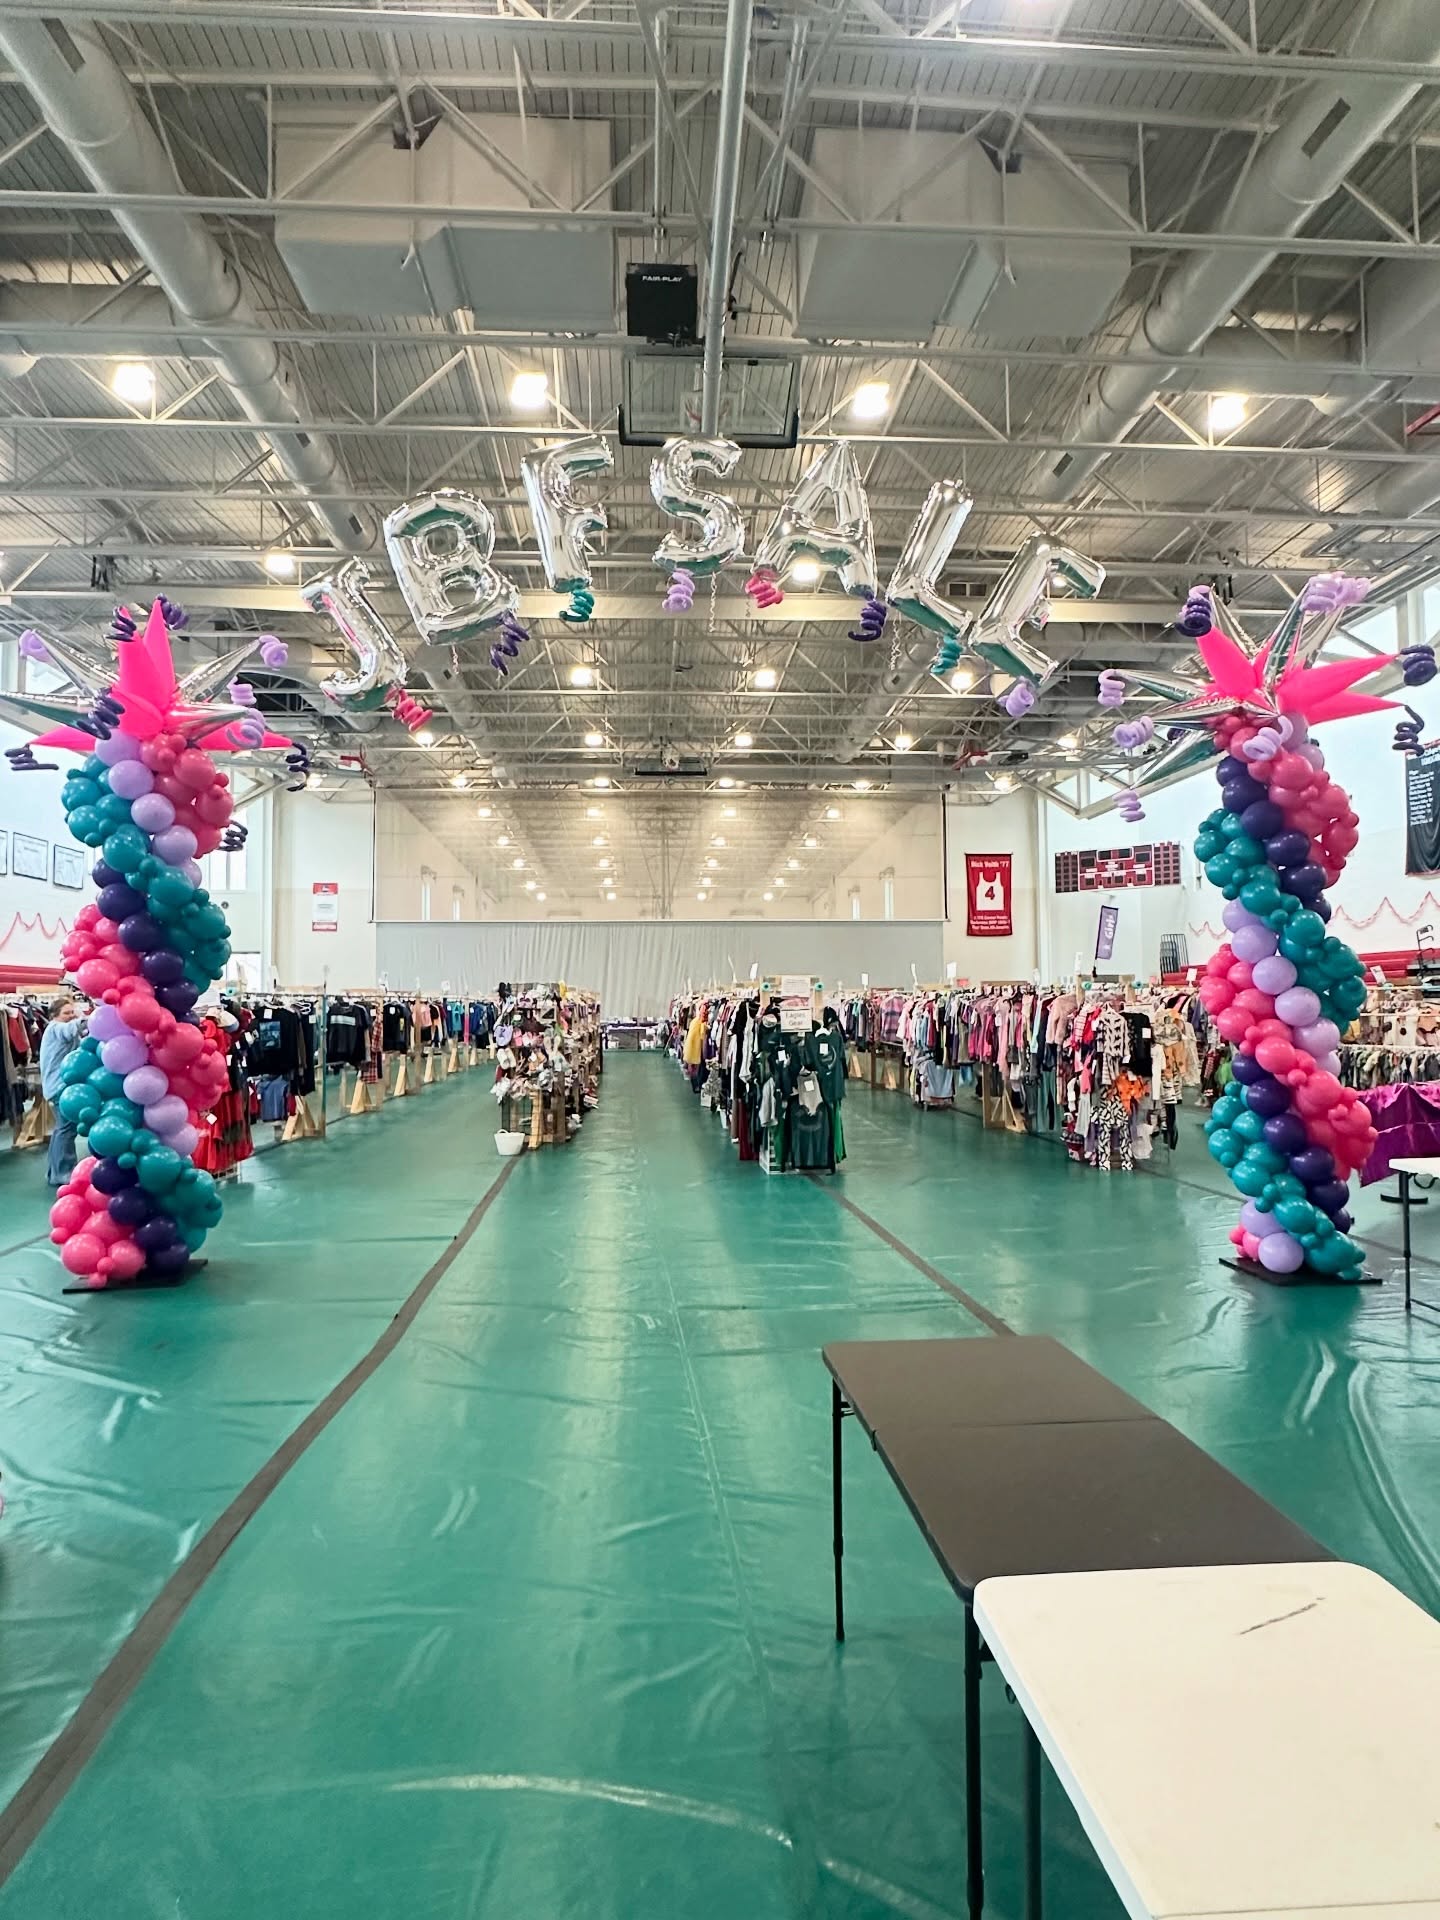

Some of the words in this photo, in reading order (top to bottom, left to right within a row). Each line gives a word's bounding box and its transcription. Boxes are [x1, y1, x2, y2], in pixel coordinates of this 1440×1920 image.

[302, 435, 614, 713] JBF
[649, 436, 1107, 688] SALE
[985, 886, 995, 900] 4
